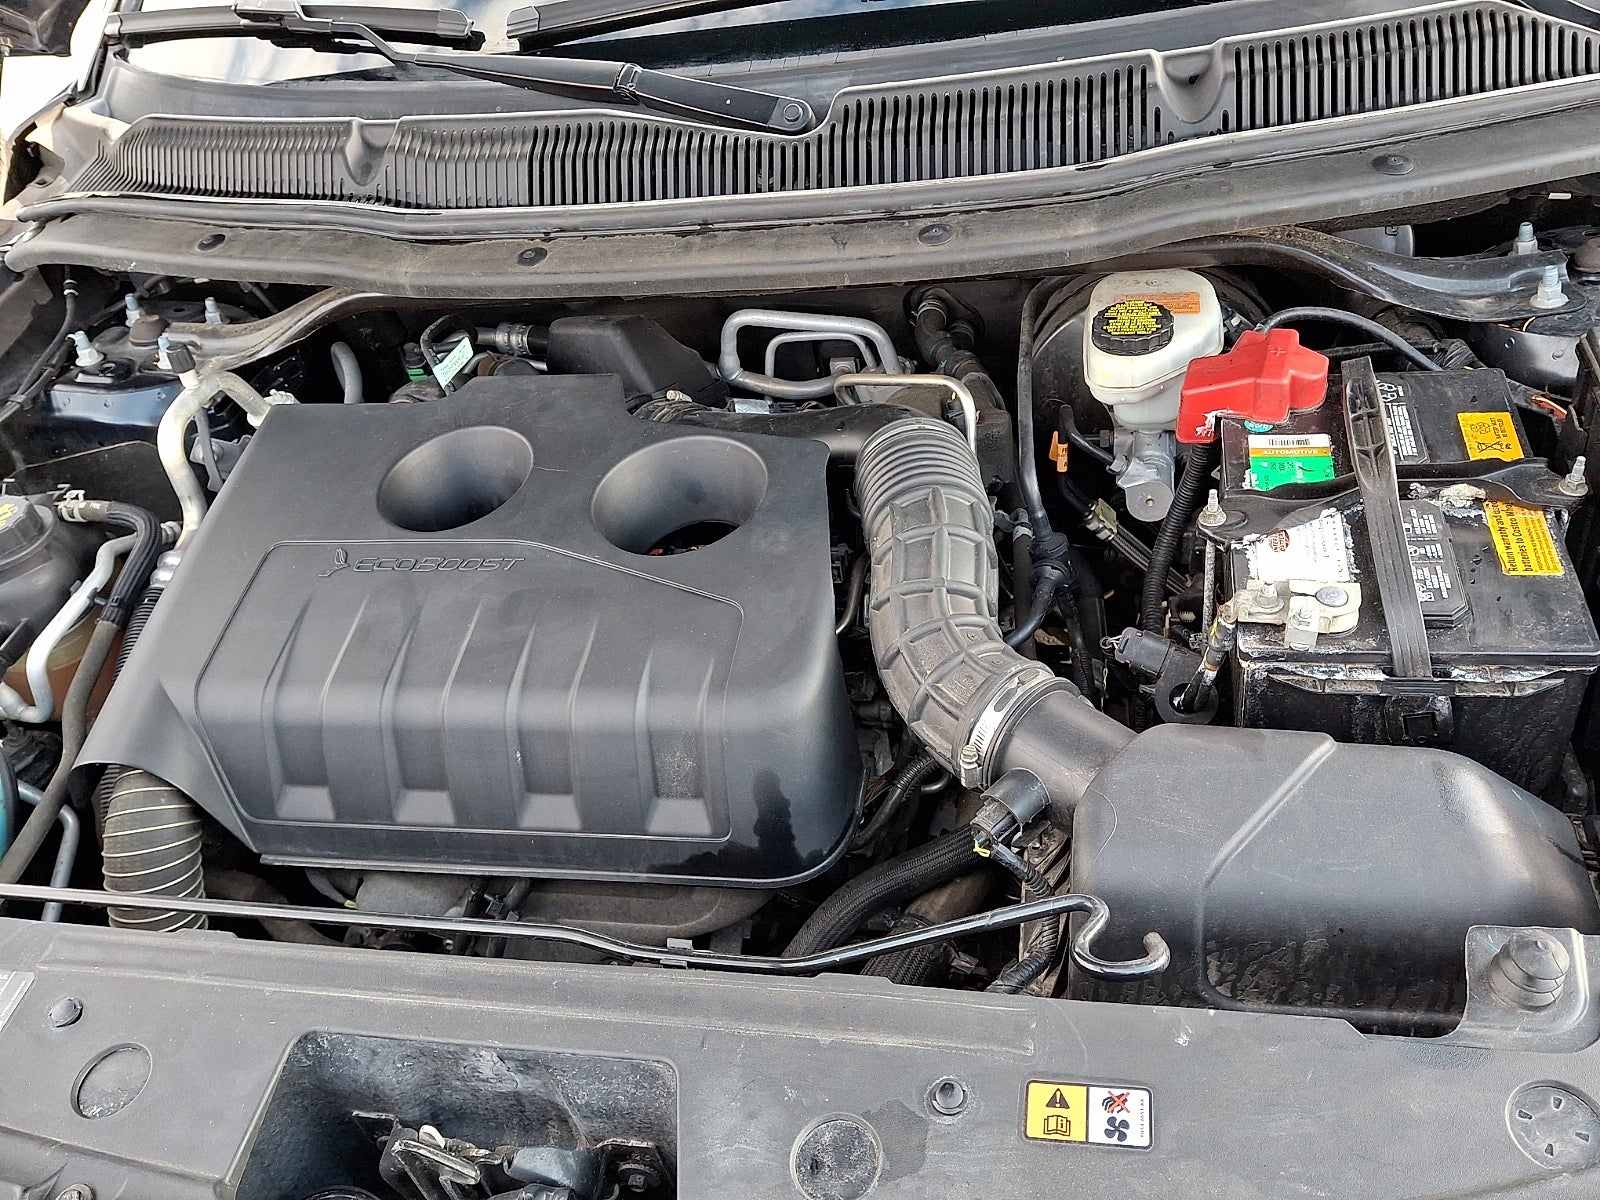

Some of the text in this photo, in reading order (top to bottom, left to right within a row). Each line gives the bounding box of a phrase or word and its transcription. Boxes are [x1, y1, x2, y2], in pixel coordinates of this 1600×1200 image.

[1492, 515, 1506, 526] and
[1510, 517, 1522, 536] Costco
[1498, 527, 1512, 550] warranty
[353, 556, 525, 572] ECOBOOST
[1506, 551, 1518, 571] Return
[1518, 545, 1533, 571] batteries
